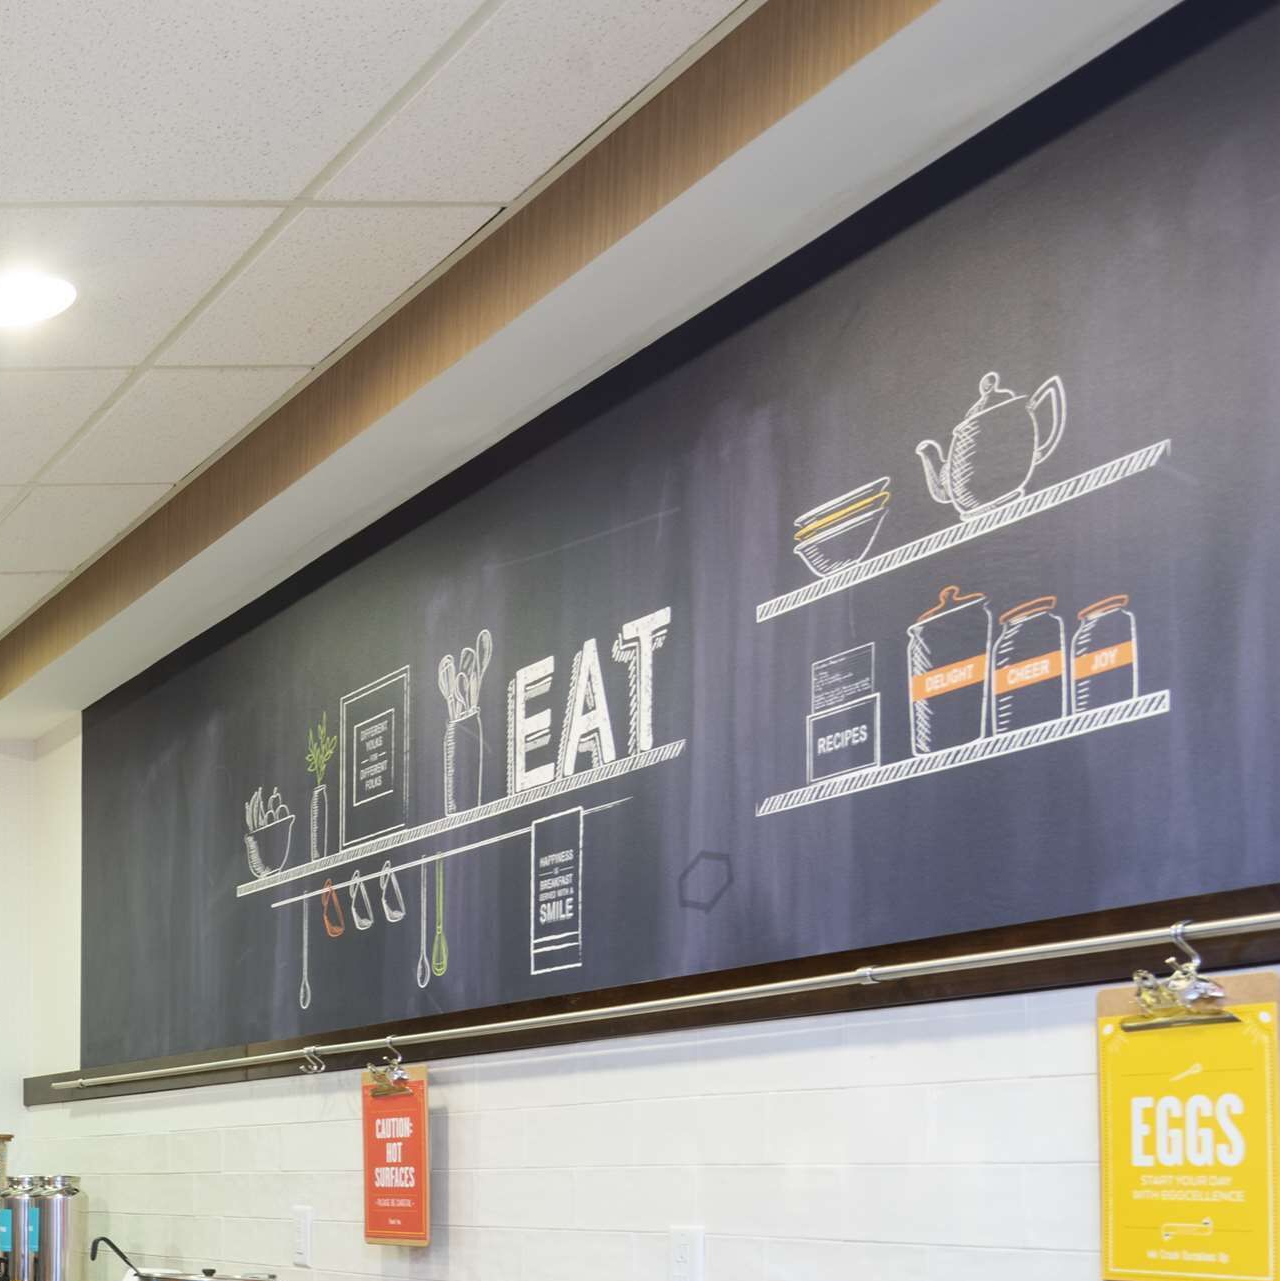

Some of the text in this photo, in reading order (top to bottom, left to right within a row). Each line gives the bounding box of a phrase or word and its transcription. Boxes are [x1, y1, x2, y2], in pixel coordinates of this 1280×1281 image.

[1093, 649, 1118, 670] JOY
[925, 664, 974, 692] DELIGHT
[1007, 659, 1050, 685] CHEER
[509, 606, 672, 796] EAT
[361, 720, 388, 741] DIFFERENT
[817, 724, 868, 755] RECIPES
[366, 736, 383, 752] YOLKS
[360, 760, 388, 780] DIFFERENT
[365, 775, 382, 791] FOLKS
[539, 849, 574, 868] HAPPINESS
[540, 873, 574, 891] BREAKFAST
[540, 897, 574, 925] SMILE
[375, 1117, 413, 1139] CAUTION:
[1131, 1093, 1245, 1167] EGGS
[385, 1142, 403, 1163] HOT
[374, 1167, 415, 1188] SURFACES
[1141, 1174, 1233, 1186] START YOUR DAY
[1132, 1190, 1246, 1201] WITH EGGCELLENCE
